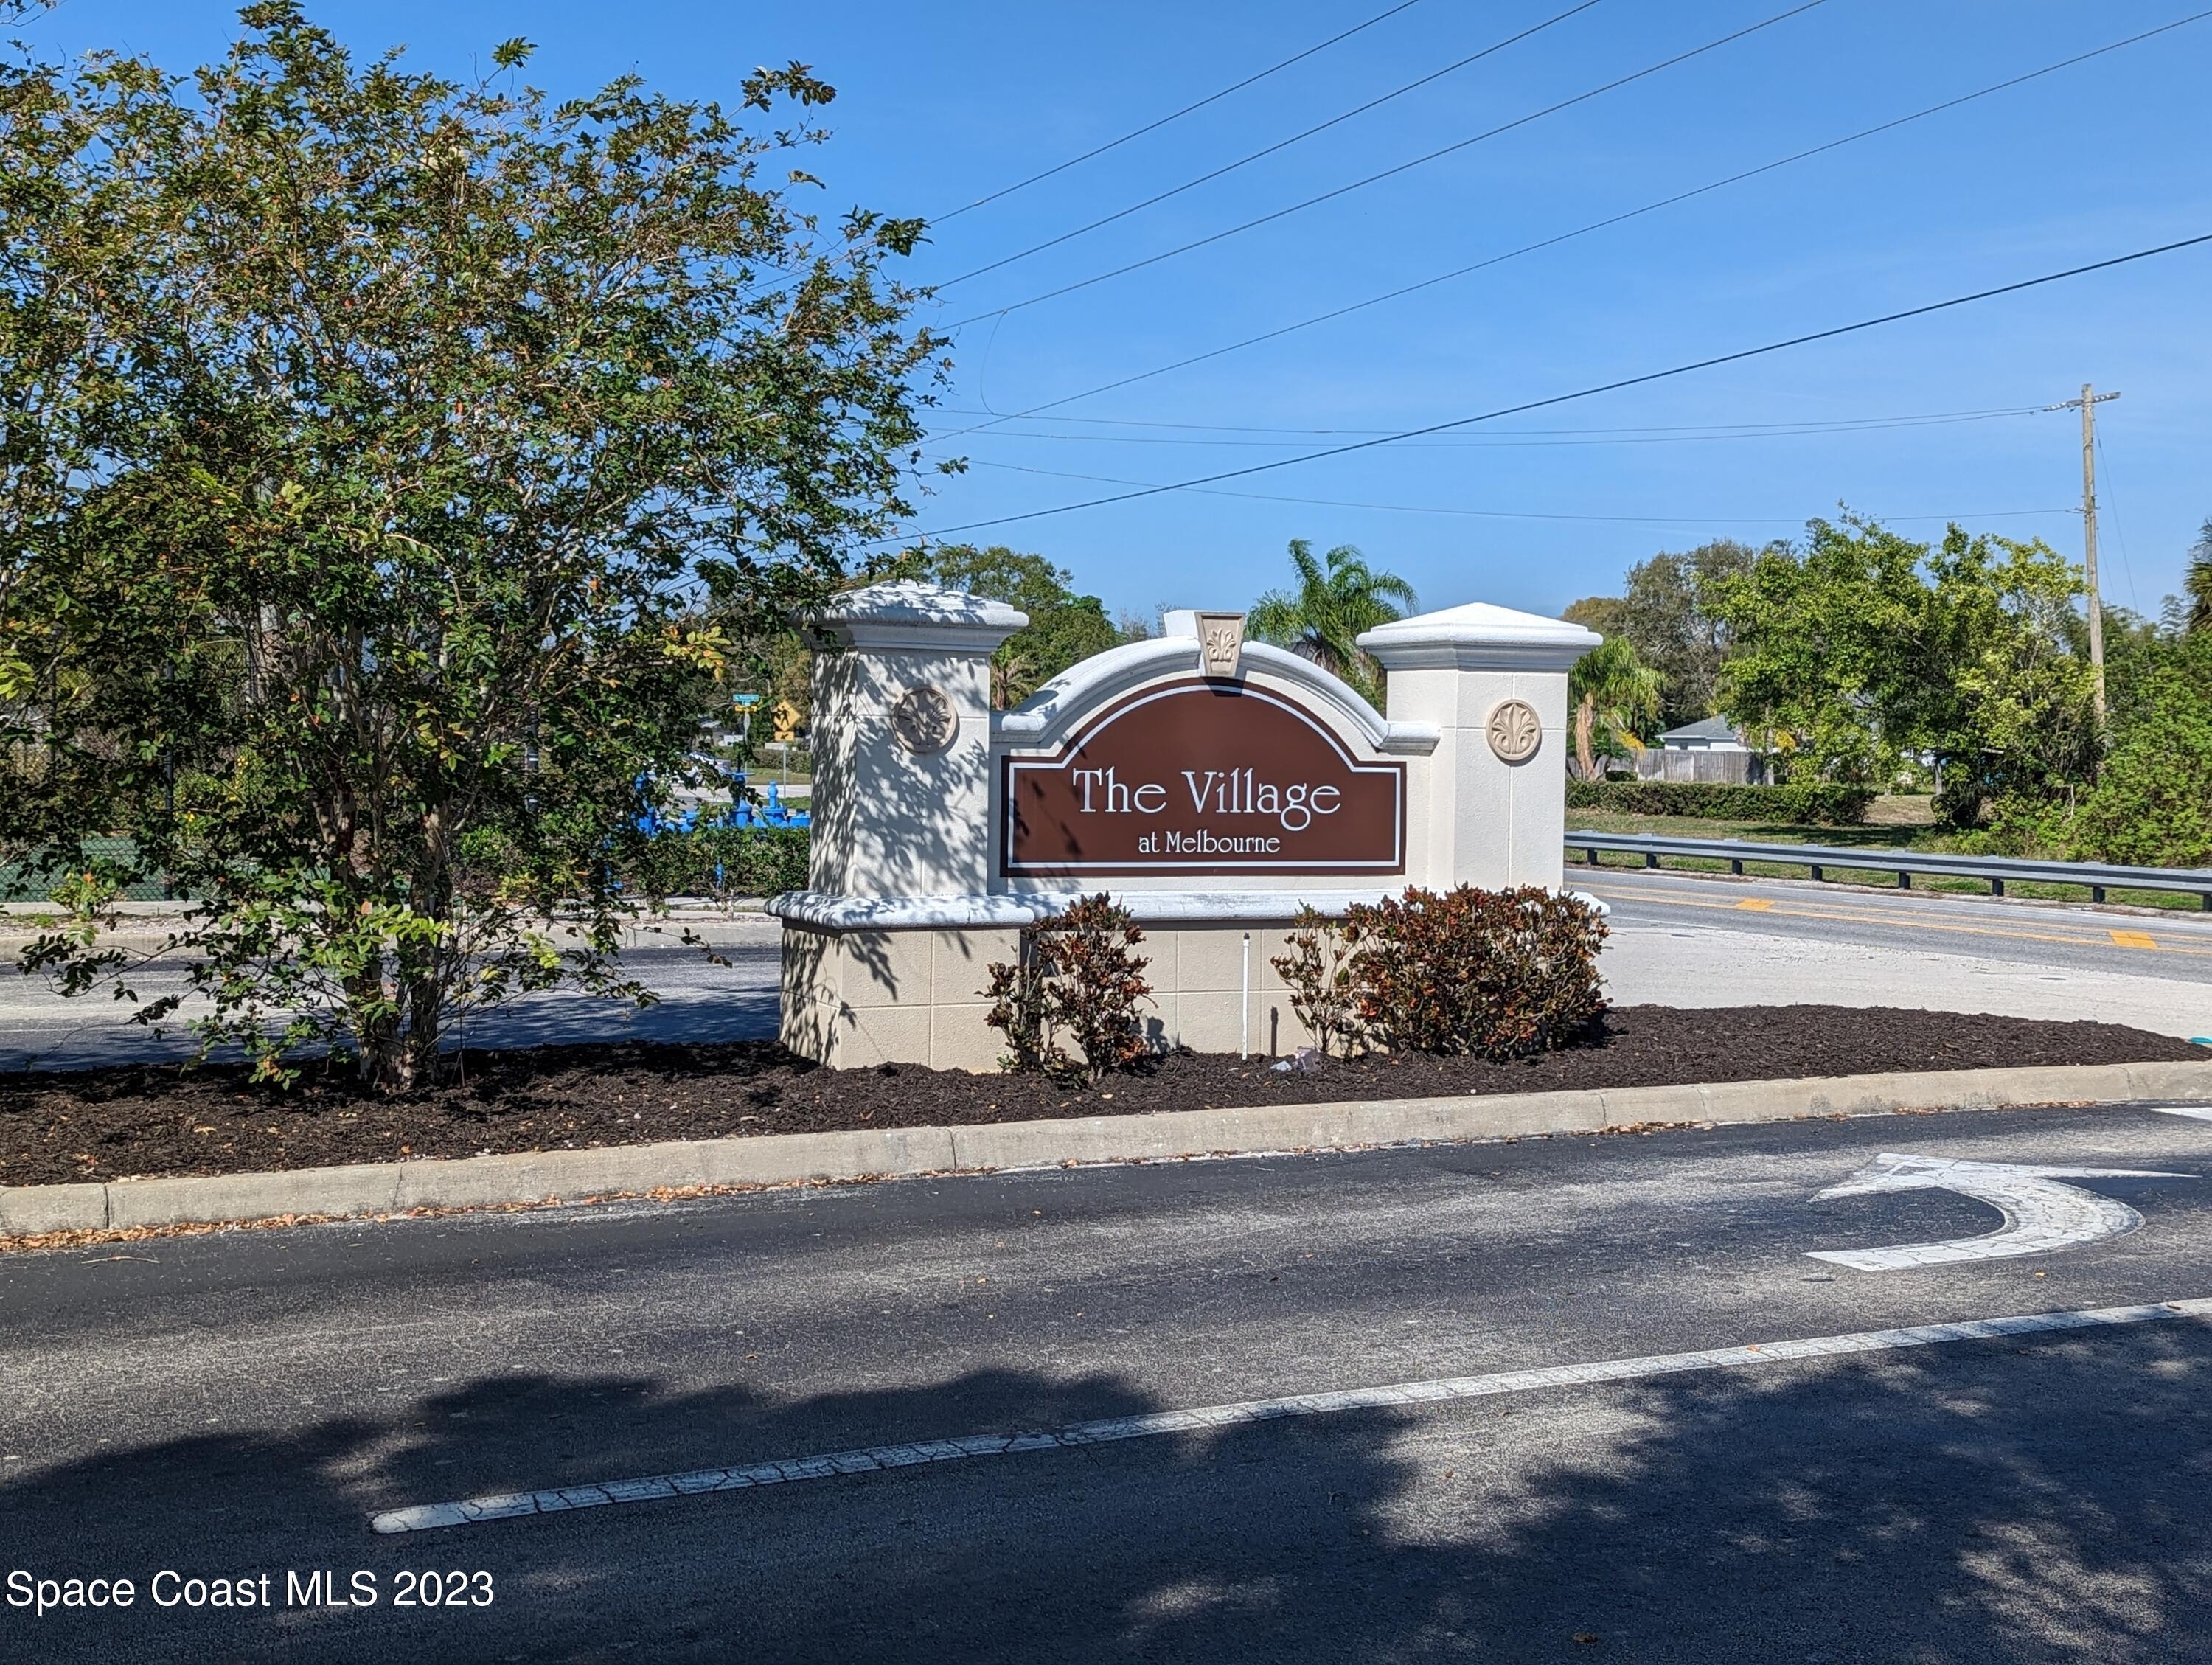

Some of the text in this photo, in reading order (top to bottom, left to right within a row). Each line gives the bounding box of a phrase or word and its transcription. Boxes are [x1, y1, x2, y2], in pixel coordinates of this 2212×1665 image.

[1072, 765, 1341, 832] The Village
[1138, 829, 1281, 854] at Melbourne
